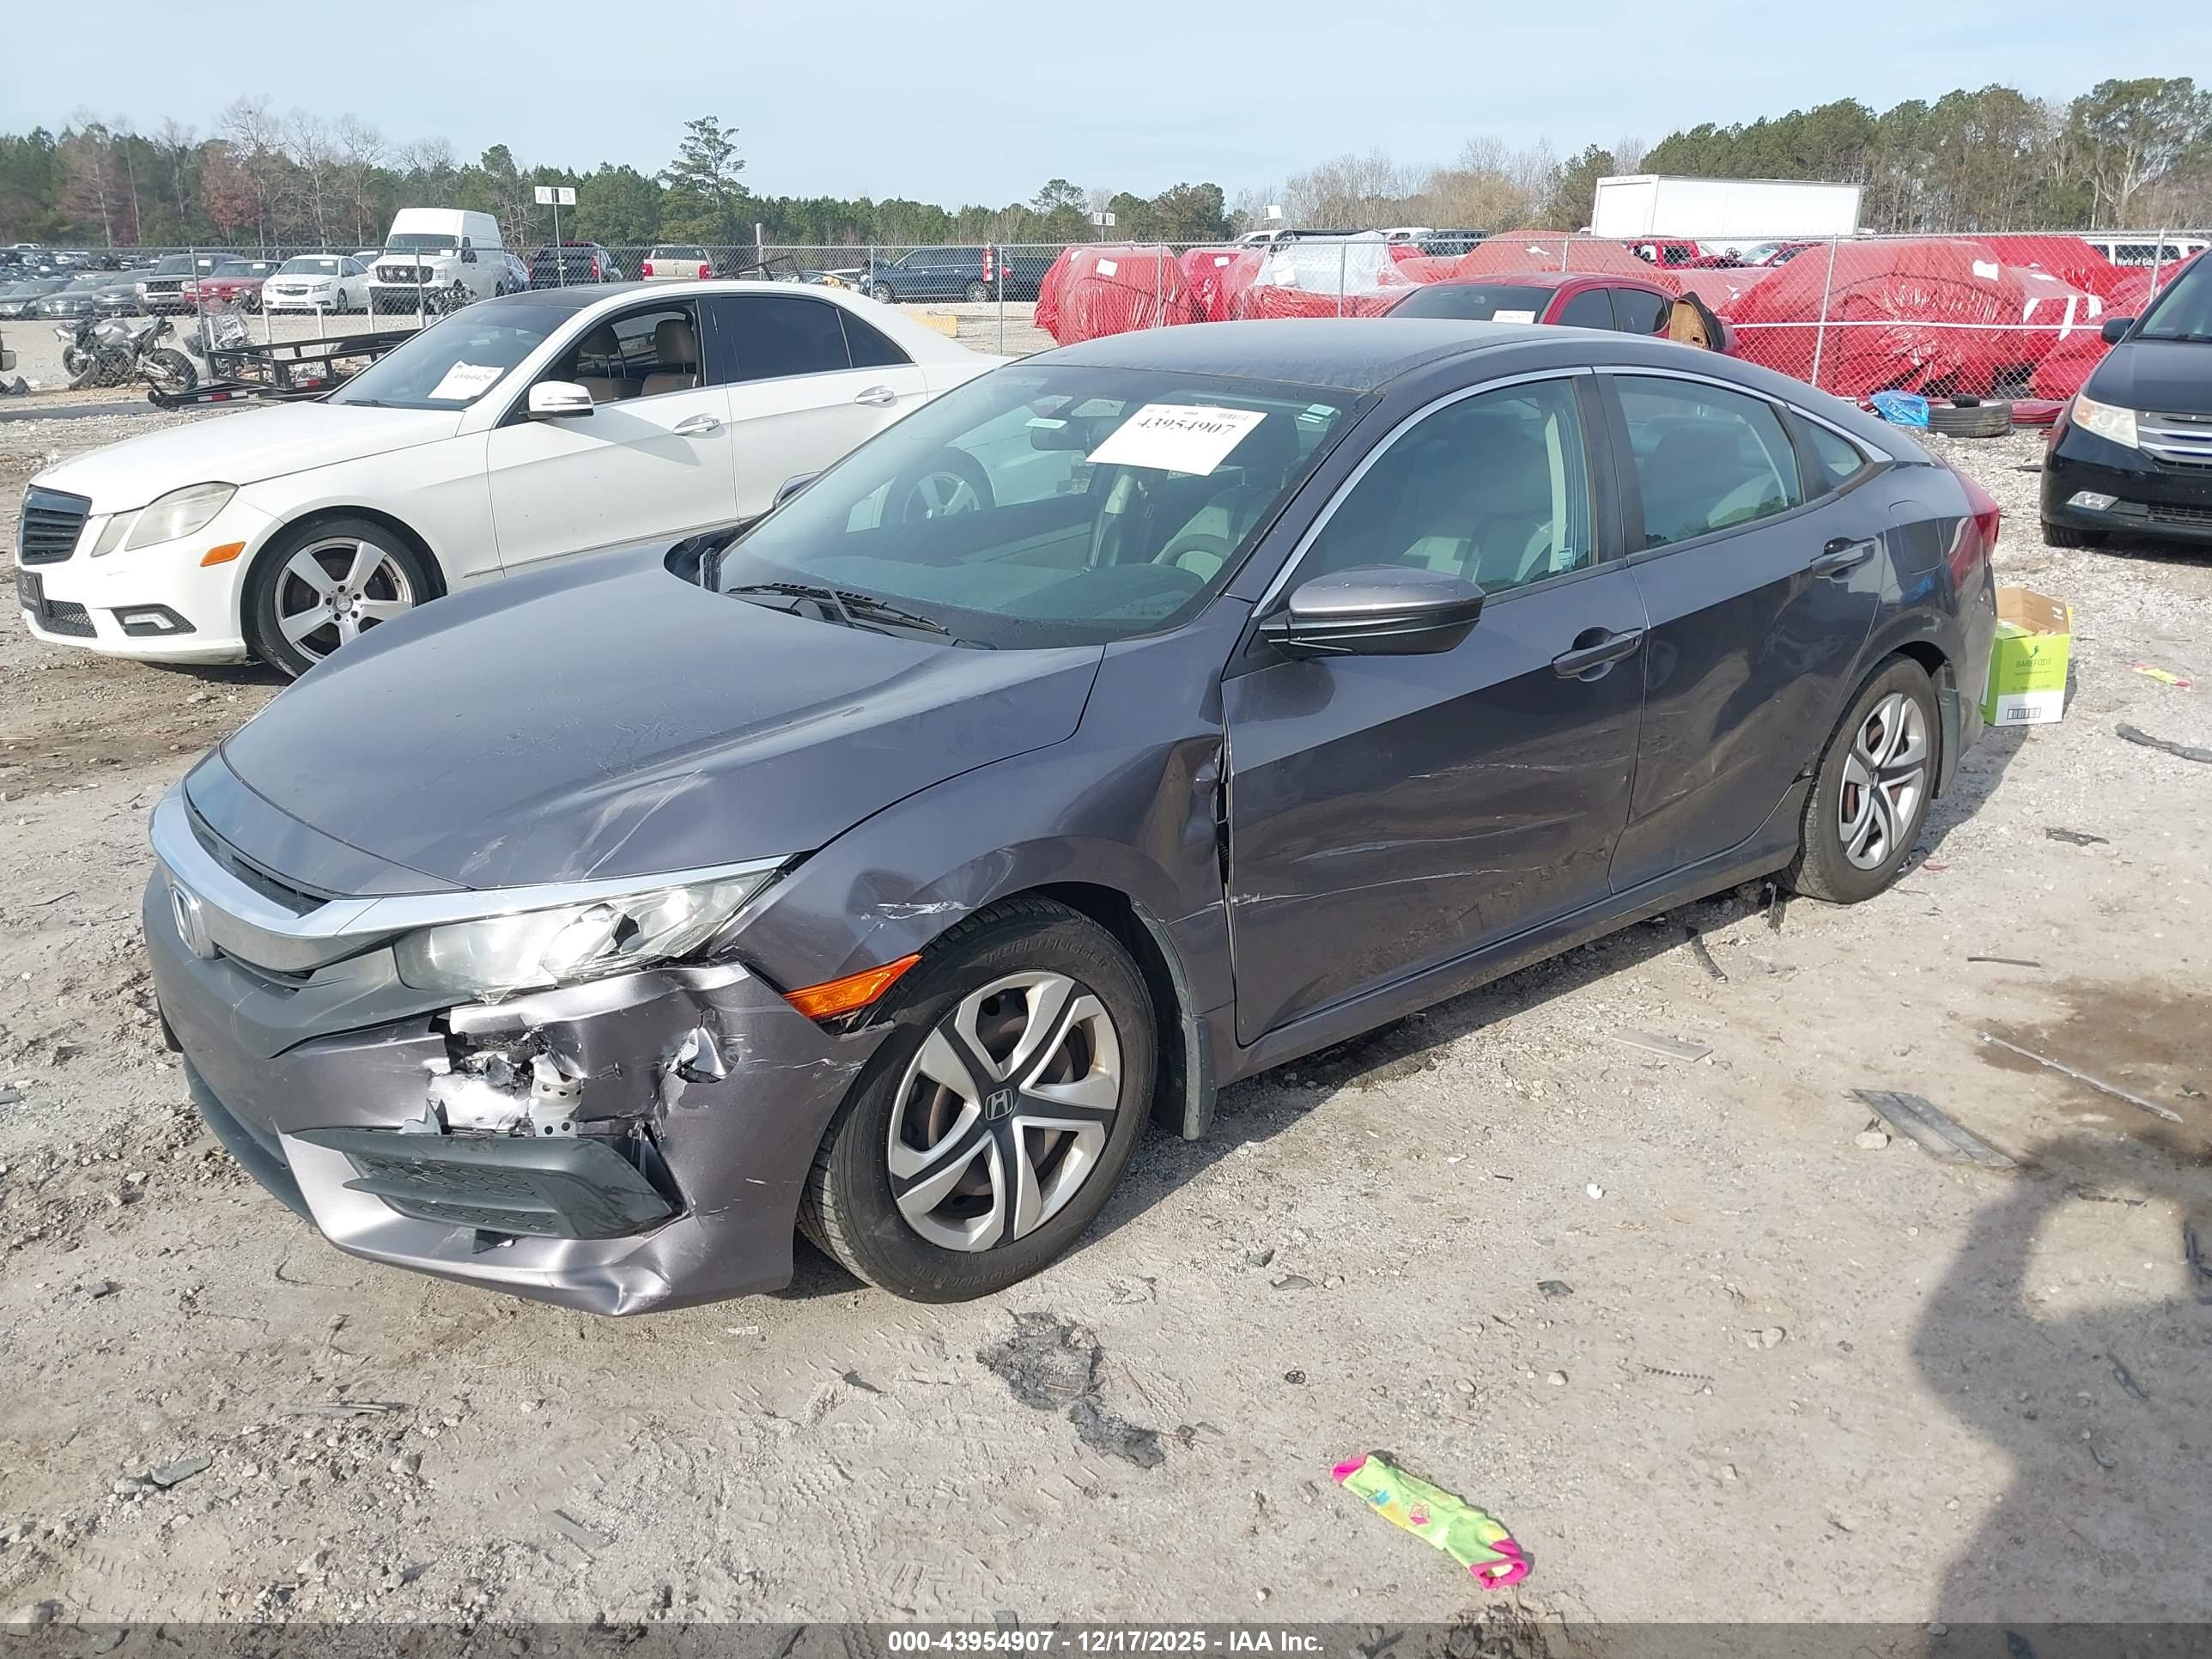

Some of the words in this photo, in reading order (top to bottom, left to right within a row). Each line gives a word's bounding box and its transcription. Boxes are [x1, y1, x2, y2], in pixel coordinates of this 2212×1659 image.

[538, 188, 550, 202] A
[563, 189, 573, 202] B
[2116, 258, 2134, 266] World
[2134, 258, 2142, 266] of
[1138, 417, 1237, 434] 43954907
